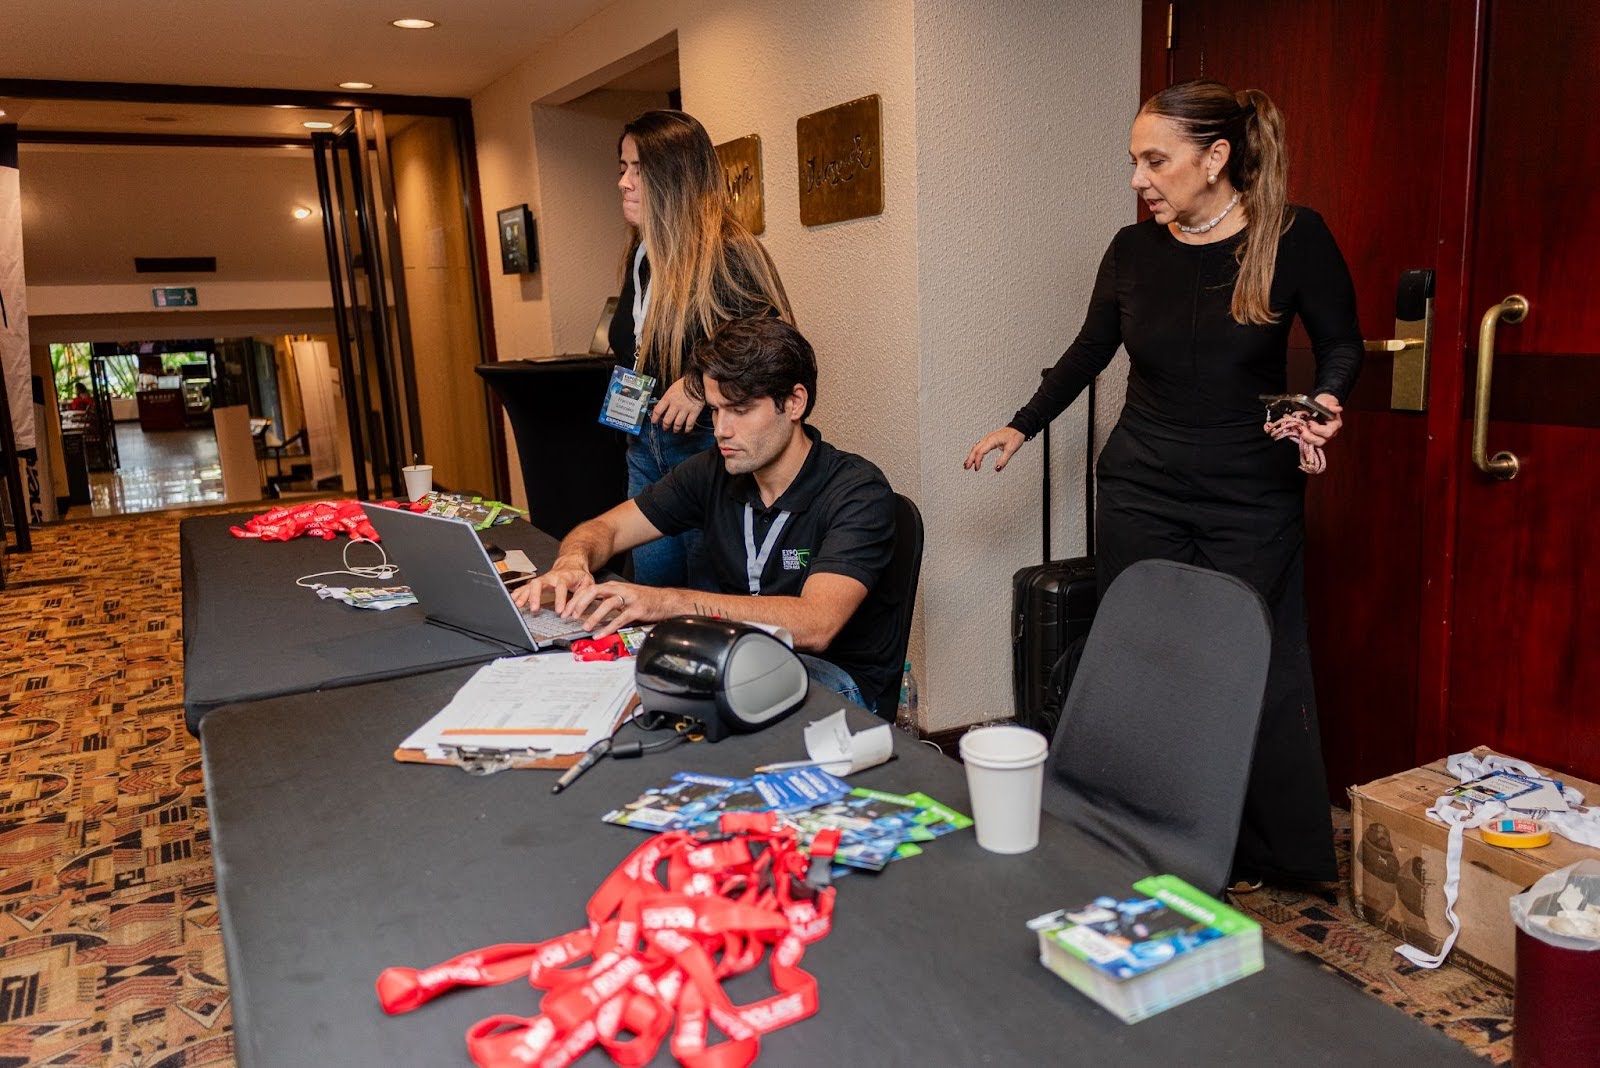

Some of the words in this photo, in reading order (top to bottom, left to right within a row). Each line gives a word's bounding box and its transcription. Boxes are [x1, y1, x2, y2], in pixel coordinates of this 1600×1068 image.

[606, 417, 634, 430] EXPOSITOR
[782, 549, 798, 557] EXPO
[1453, 953, 1468, 964] See
[1468, 959, 1481, 972] the
